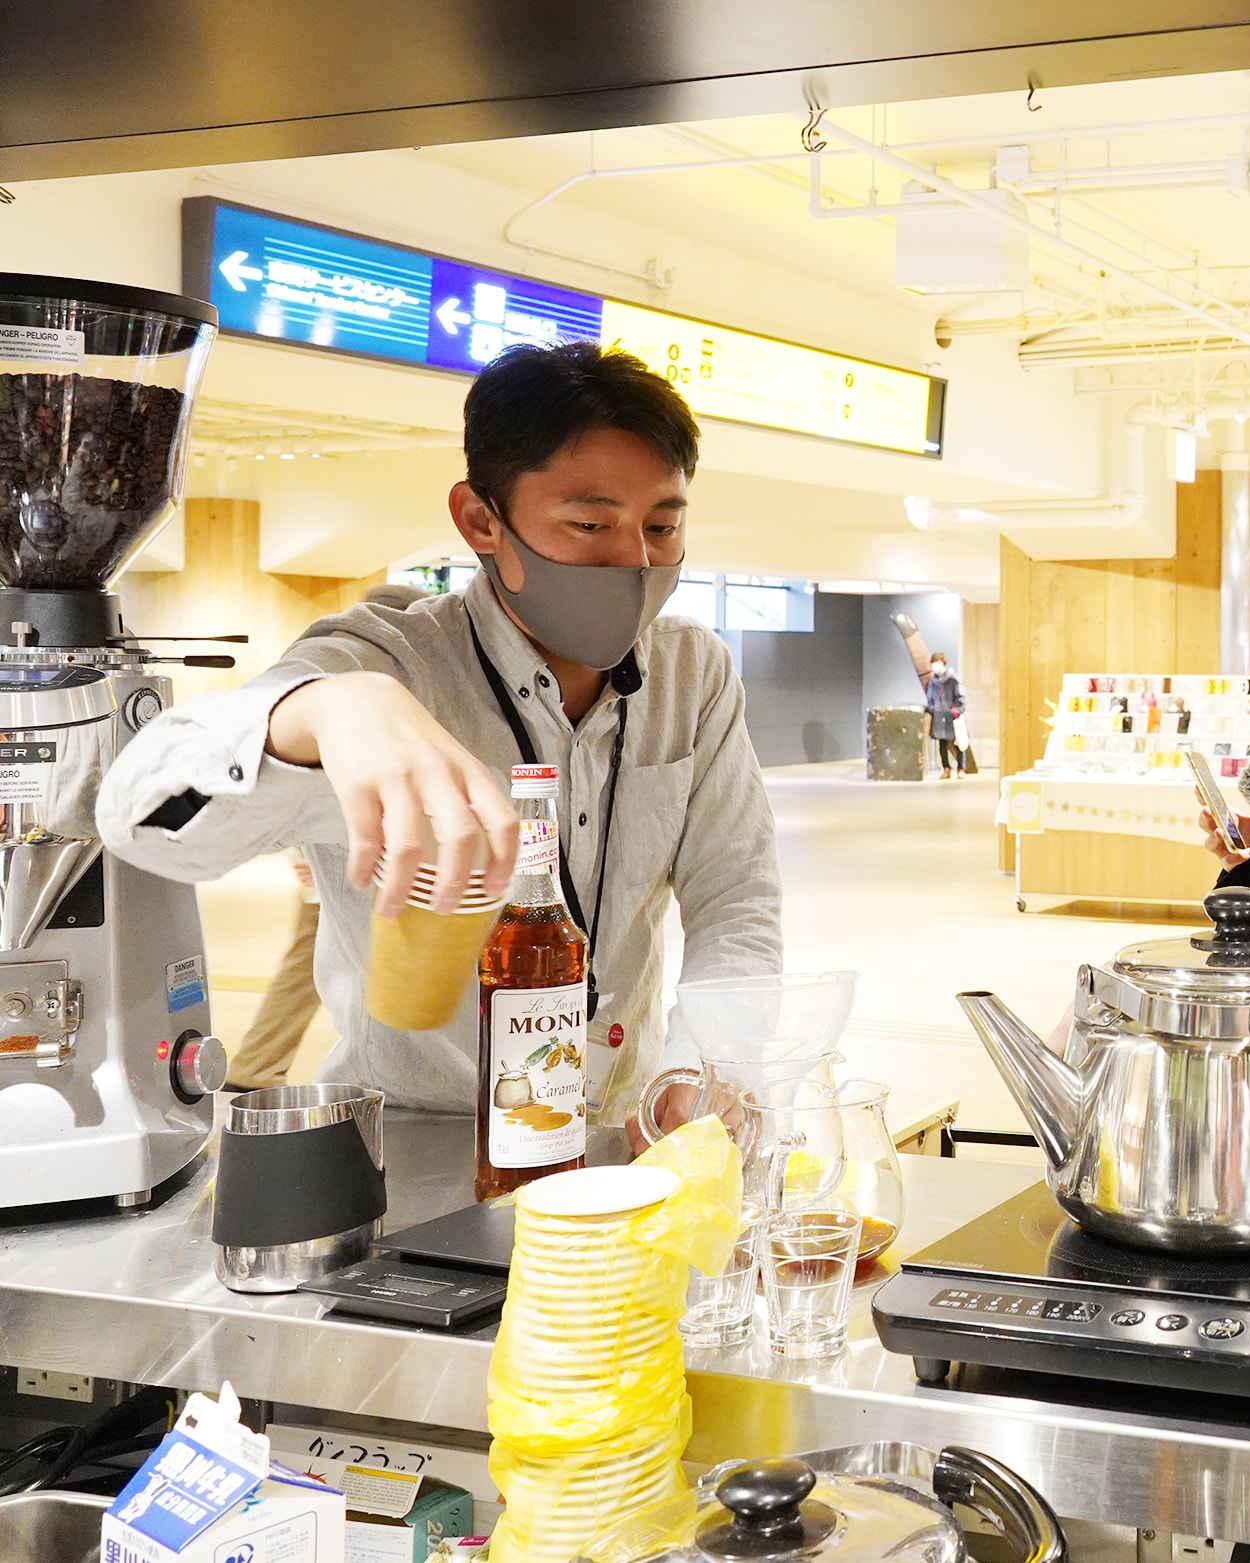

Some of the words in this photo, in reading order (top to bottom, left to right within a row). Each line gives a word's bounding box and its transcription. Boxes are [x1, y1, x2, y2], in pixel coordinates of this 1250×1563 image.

[26, 331, 58, 342] PELIGRO
[0, 748, 28, 758] ER
[536, 1077, 581, 1099] Caramel
[153, 1441, 246, 1506] 黒川牛乳
